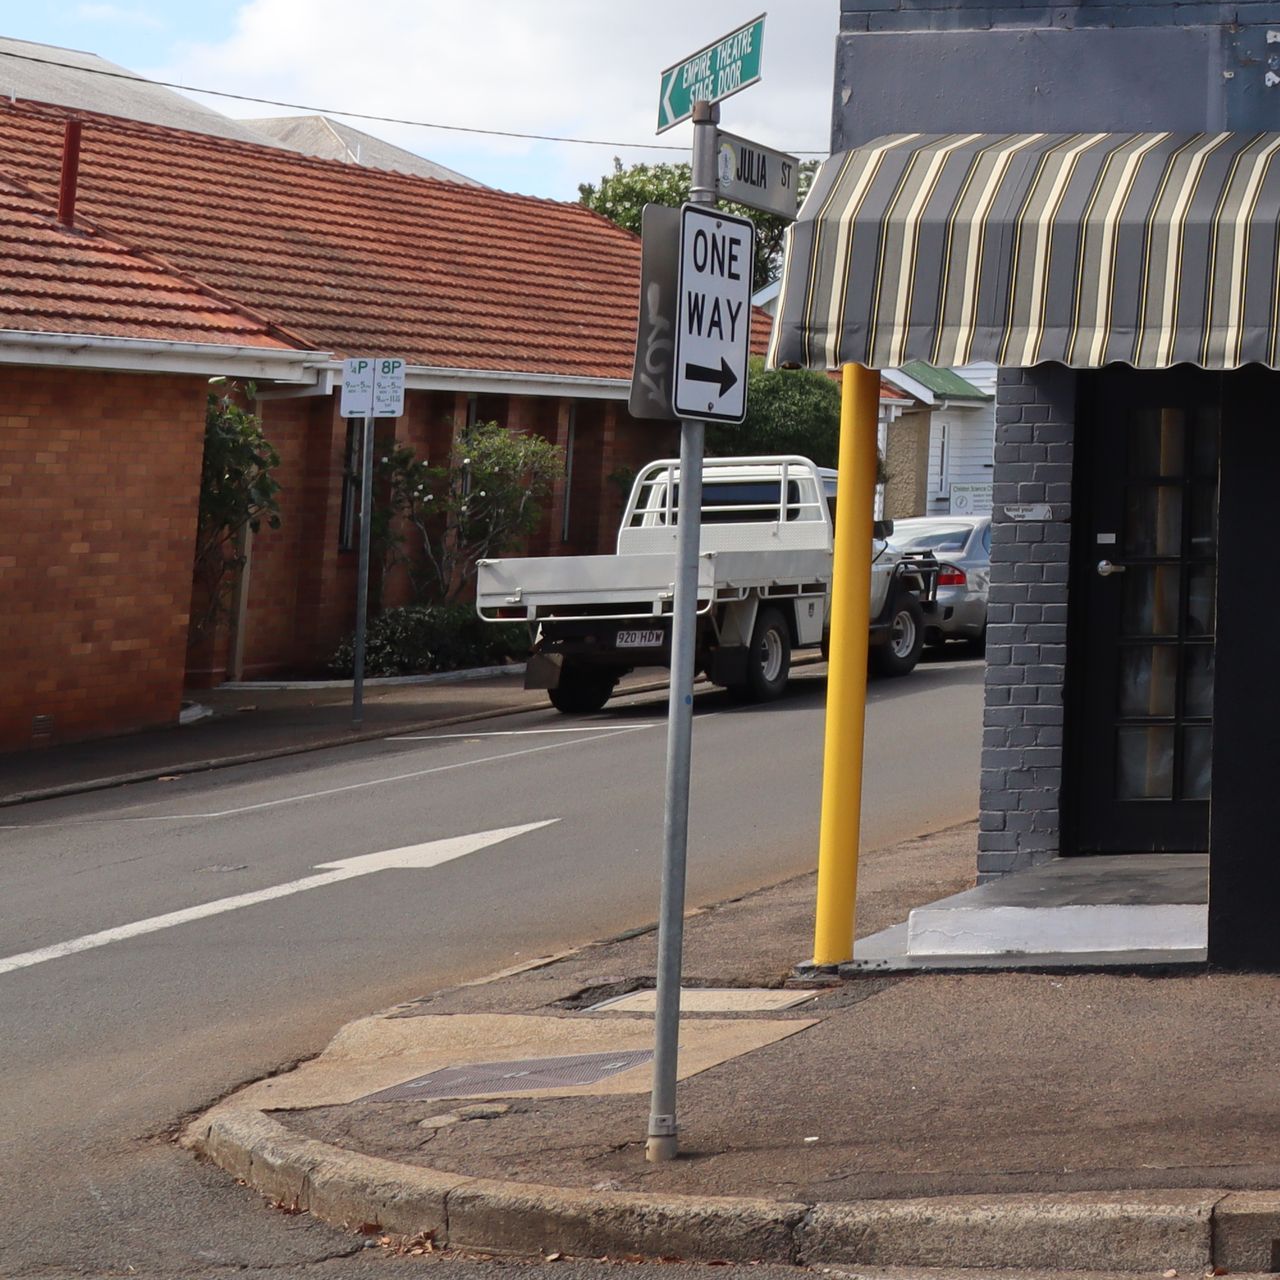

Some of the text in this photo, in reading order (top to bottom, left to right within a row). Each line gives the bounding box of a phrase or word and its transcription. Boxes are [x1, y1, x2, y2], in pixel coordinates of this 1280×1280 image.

[683, 26, 754, 89] EMPIRE THEATRE
[689, 60, 742, 113] STAGE DOOR
[736, 147, 792, 189] JULIA ST
[693, 229, 741, 281] ONE
[688, 290, 742, 343] WAY
[381, 361, 401, 374] 8P
[618, 632, 637, 643] 920
